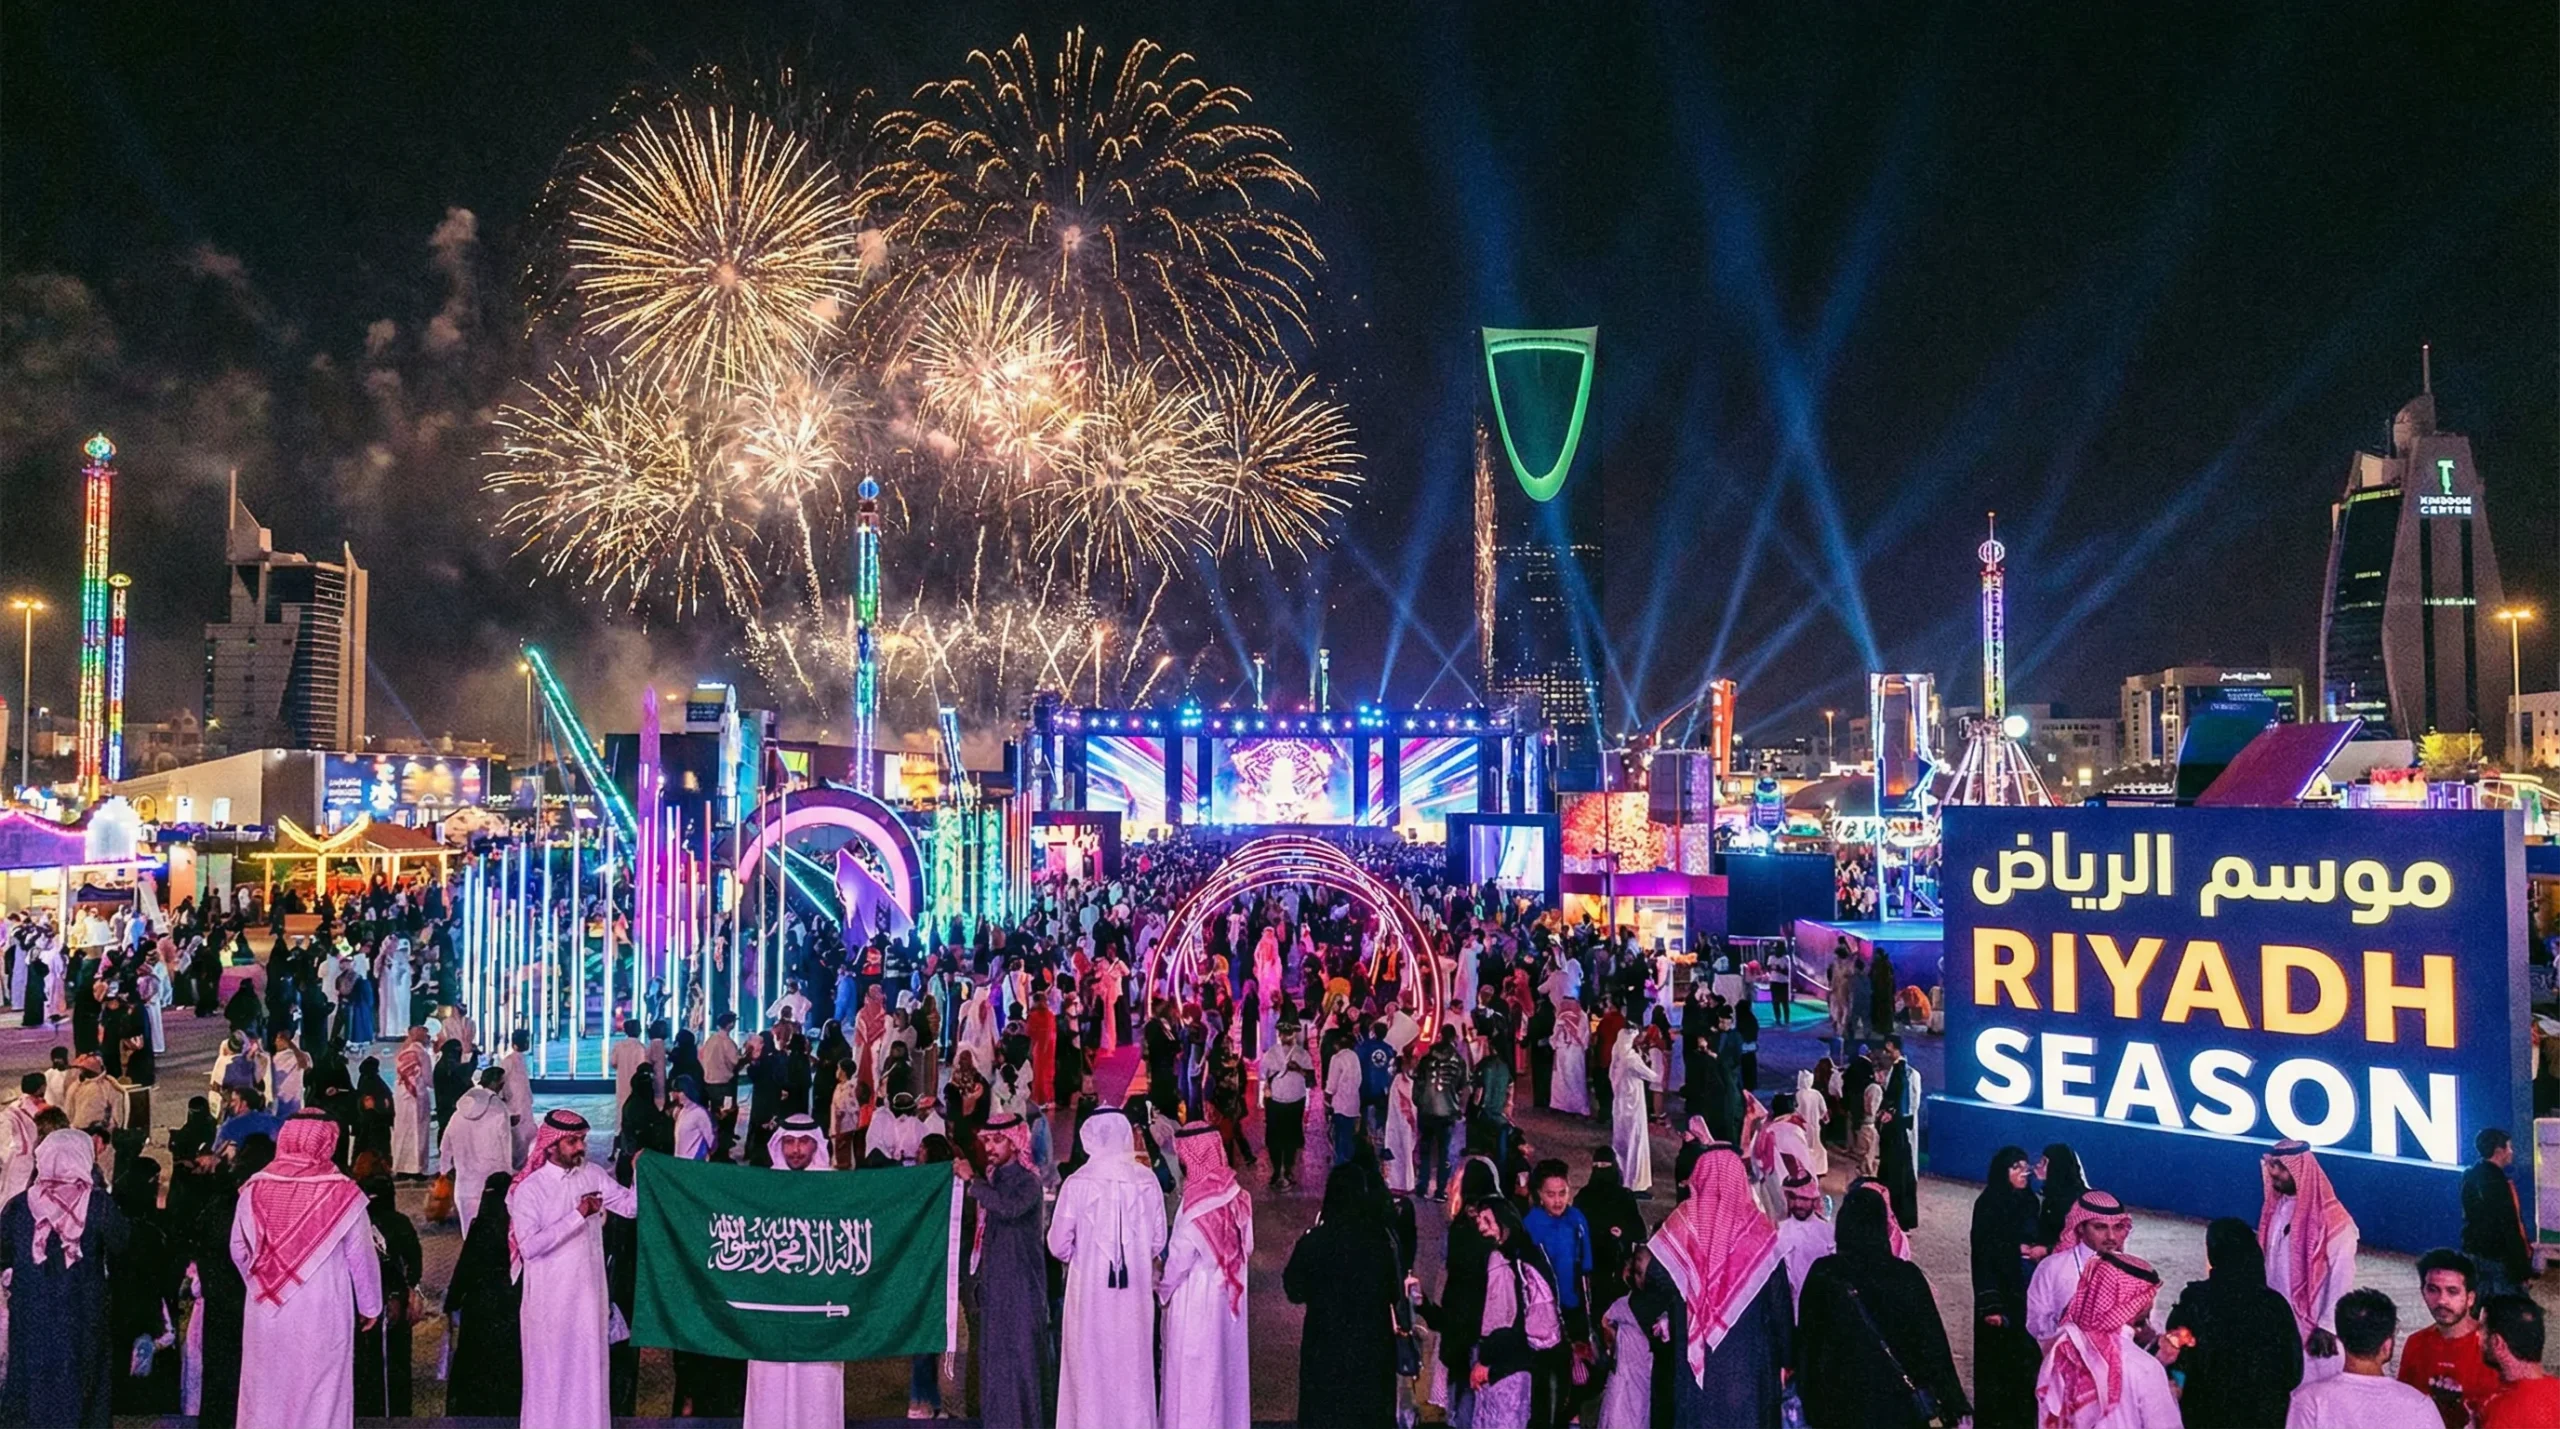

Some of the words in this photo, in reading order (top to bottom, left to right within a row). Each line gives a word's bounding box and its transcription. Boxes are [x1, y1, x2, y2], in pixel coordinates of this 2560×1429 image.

[1972, 831, 2173, 912] الرياض
[2199, 855, 2454, 924] موسم
[1973, 926, 2456, 1049] RIYADH
[1974, 1026, 2461, 1166] SEASON
